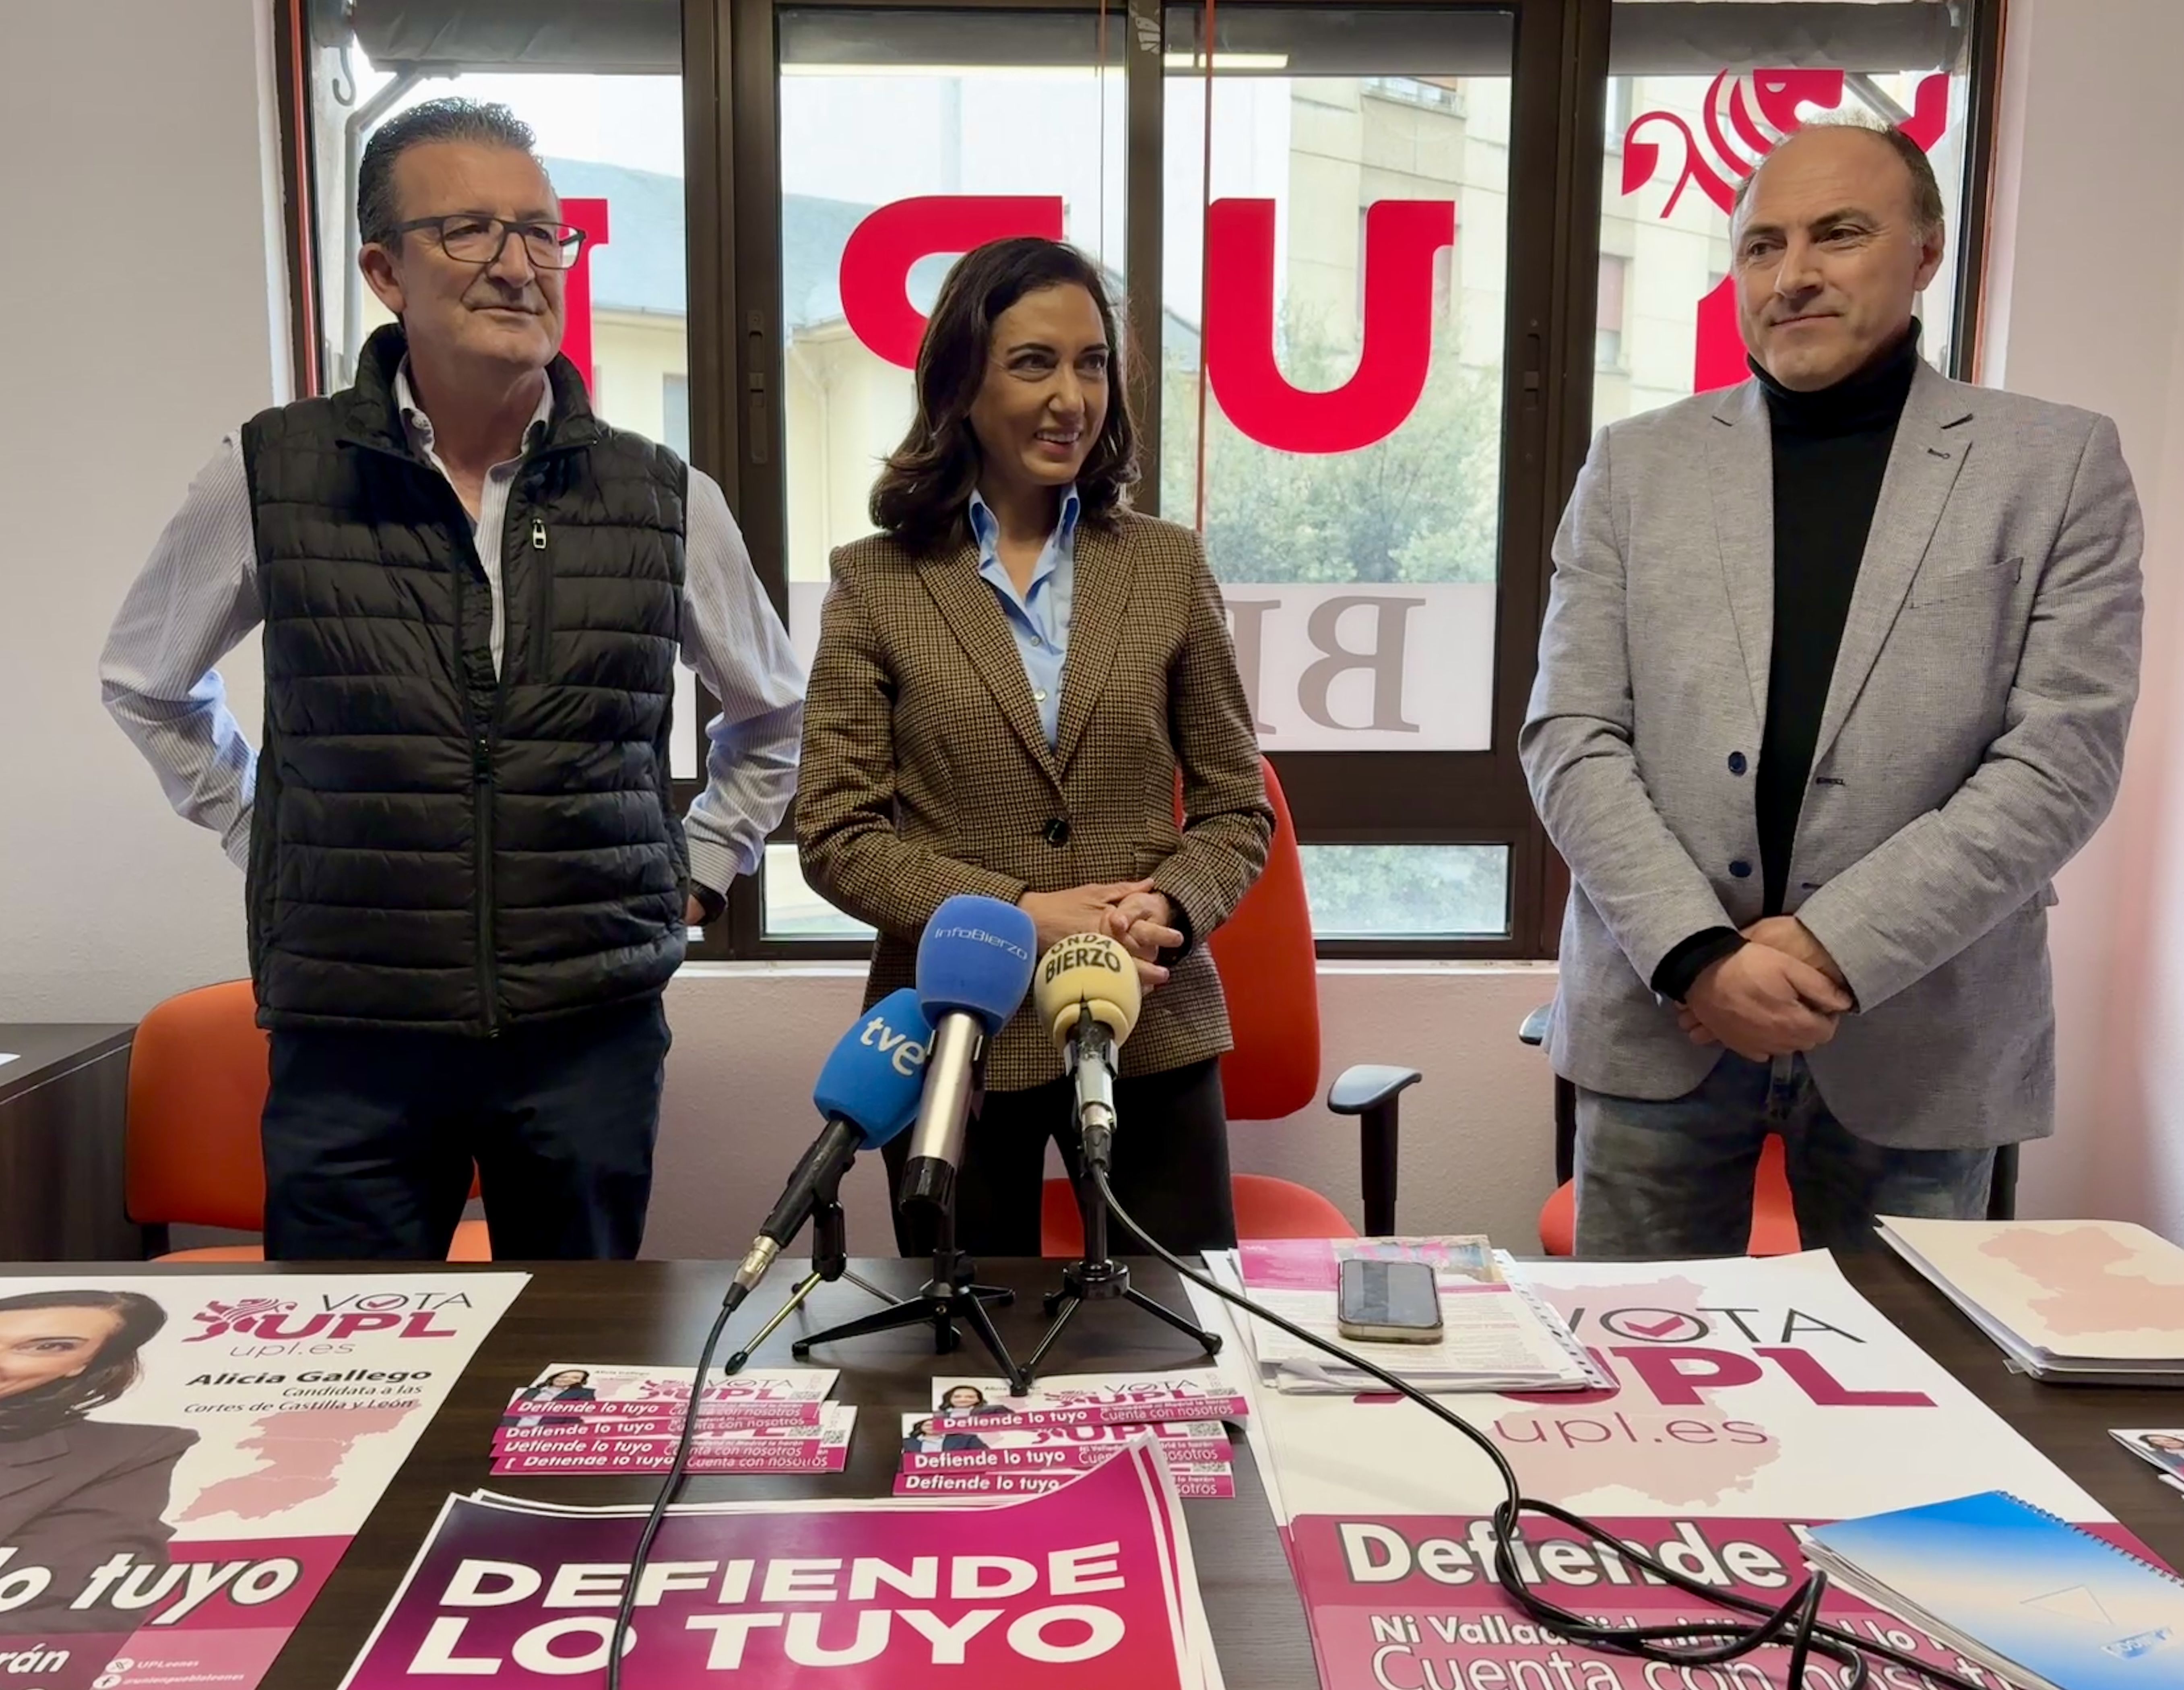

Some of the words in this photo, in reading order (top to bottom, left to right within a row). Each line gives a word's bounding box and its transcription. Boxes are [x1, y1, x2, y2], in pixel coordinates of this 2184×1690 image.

[935, 927, 1028, 961] InfoBierzo
[1051, 934, 1112, 954] ONDA
[1046, 947, 1121, 984] BIERZO
[860, 1016, 925, 1076] tve
[322, 1292, 473, 1311] VOTA
[254, 1311, 458, 1339] UPL
[229, 1341, 357, 1359] upl.es
[185, 1371, 287, 1386] Alicia
[296, 1369, 433, 1385] Gallego
[707, 1379, 794, 1388] VOTA
[282, 1385, 377, 1397] Candidata
[394, 1384, 422, 1395] las
[184, 1403, 244, 1414] Cortes
[249, 1401, 275, 1412] de
[279, 1399, 347, 1411] Castilla
[349, 1402, 365, 1412] y
[367, 1398, 415, 1409] León
[518, 1402, 597, 1413] Defiende
[601, 1401, 617, 1413] lo
[621, 1403, 659, 1415] tuyo
[943, 1414, 1023, 1428] Defiende
[1028, 1413, 1044, 1423] lo
[1049, 1410, 1087, 1424] tuyo
[1100, 1411, 1146, 1421] Cuenta
[506, 1423, 588, 1438] Defiende
[594, 1422, 611, 1433] lo
[1493, 1411, 1769, 1449] upl.es
[591, 1440, 609, 1451] lo
[614, 1440, 653, 1454] tuyo
[744, 1445, 802, 1455] nosotros
[914, 1452, 998, 1468] Defiende
[1004, 1450, 1021, 1464] lo
[1027, 1450, 1065, 1466] tuyo
[905, 1475, 991, 1489] Defiende
[997, 1477, 1013, 1489] lo
[1020, 1478, 1061, 1492] tuyo
[1338, 1521, 1788, 1587] Defiende
[440, 1541, 1127, 1608] DEFIENDE
[69, 1553, 299, 1625] tuyo
[1370, 1615, 1421, 1643] Ni
[407, 1616, 637, 1676] LO
[685, 1604, 1126, 1671] TUYO
